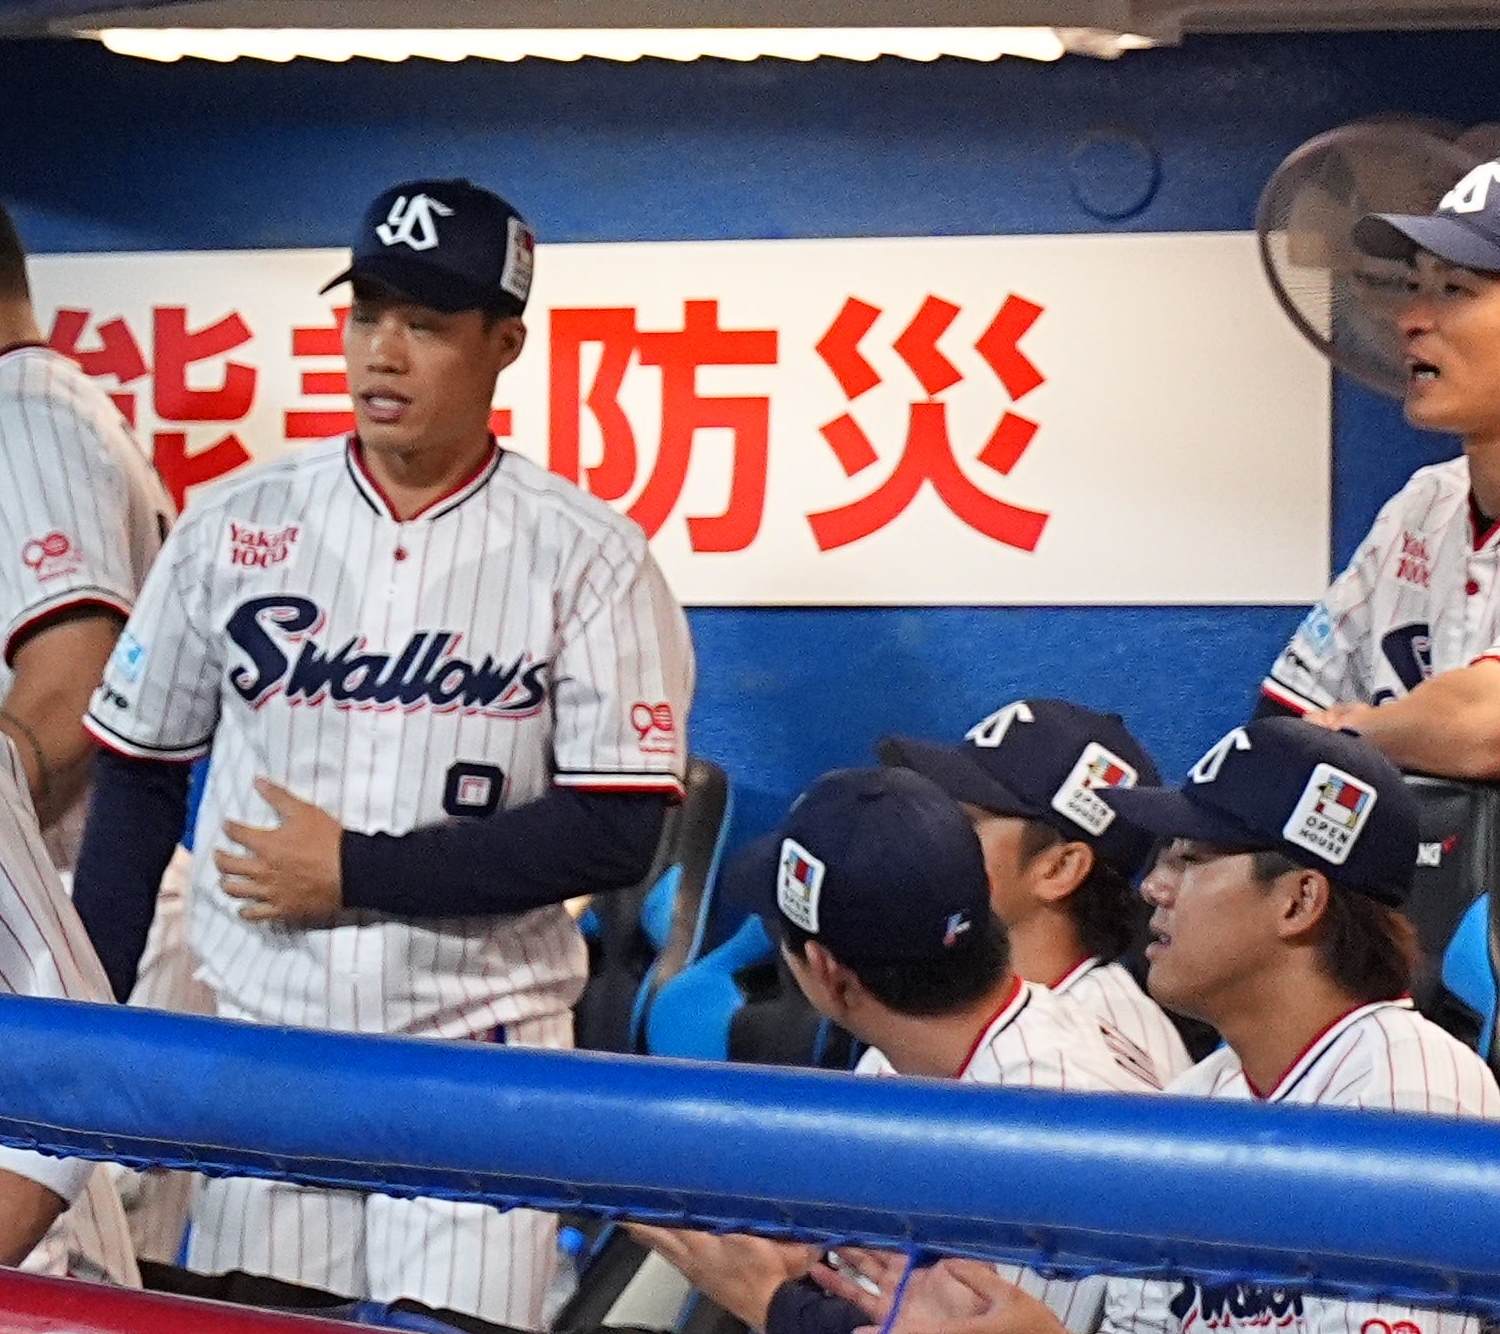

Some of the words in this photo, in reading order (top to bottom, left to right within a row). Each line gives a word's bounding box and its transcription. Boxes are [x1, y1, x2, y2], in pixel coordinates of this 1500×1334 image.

[226, 595, 551, 719] Swallows
[1298, 827, 1345, 856] HOUSE
[1305, 815, 1350, 845] OPEN
